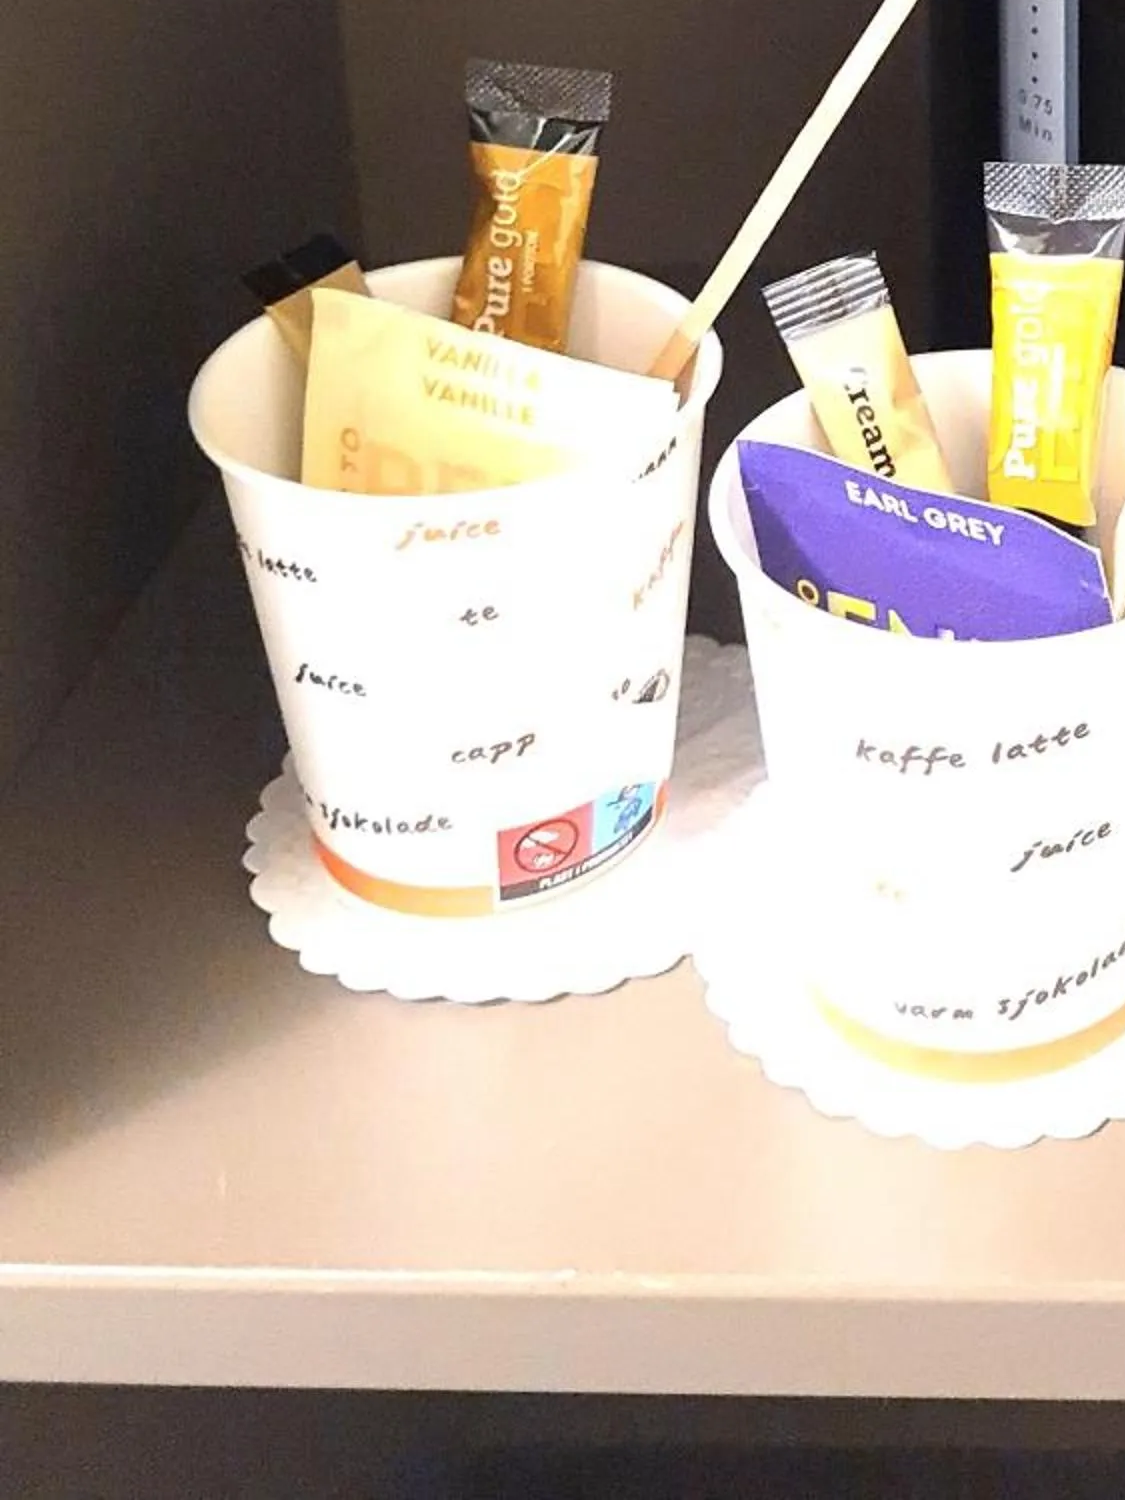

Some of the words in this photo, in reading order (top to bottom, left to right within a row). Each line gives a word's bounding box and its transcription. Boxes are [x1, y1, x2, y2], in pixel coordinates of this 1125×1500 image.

[489, 169, 523, 248] gold
[473, 256, 513, 336] Pure
[1011, 278, 1050, 367] gold
[844, 480, 919, 523] EARL
[923, 507, 1005, 546] GREY
[395, 520, 502, 551] juice
[257, 549, 317, 583] latte
[459, 606, 499, 627] te
[293, 662, 367, 697] juice
[451, 732, 536, 765] capp
[855, 738, 967, 777] kaffe
[991, 722, 1091, 765] latte
[1010, 821, 1113, 873] juice
[894, 1002, 974, 1020] varm
